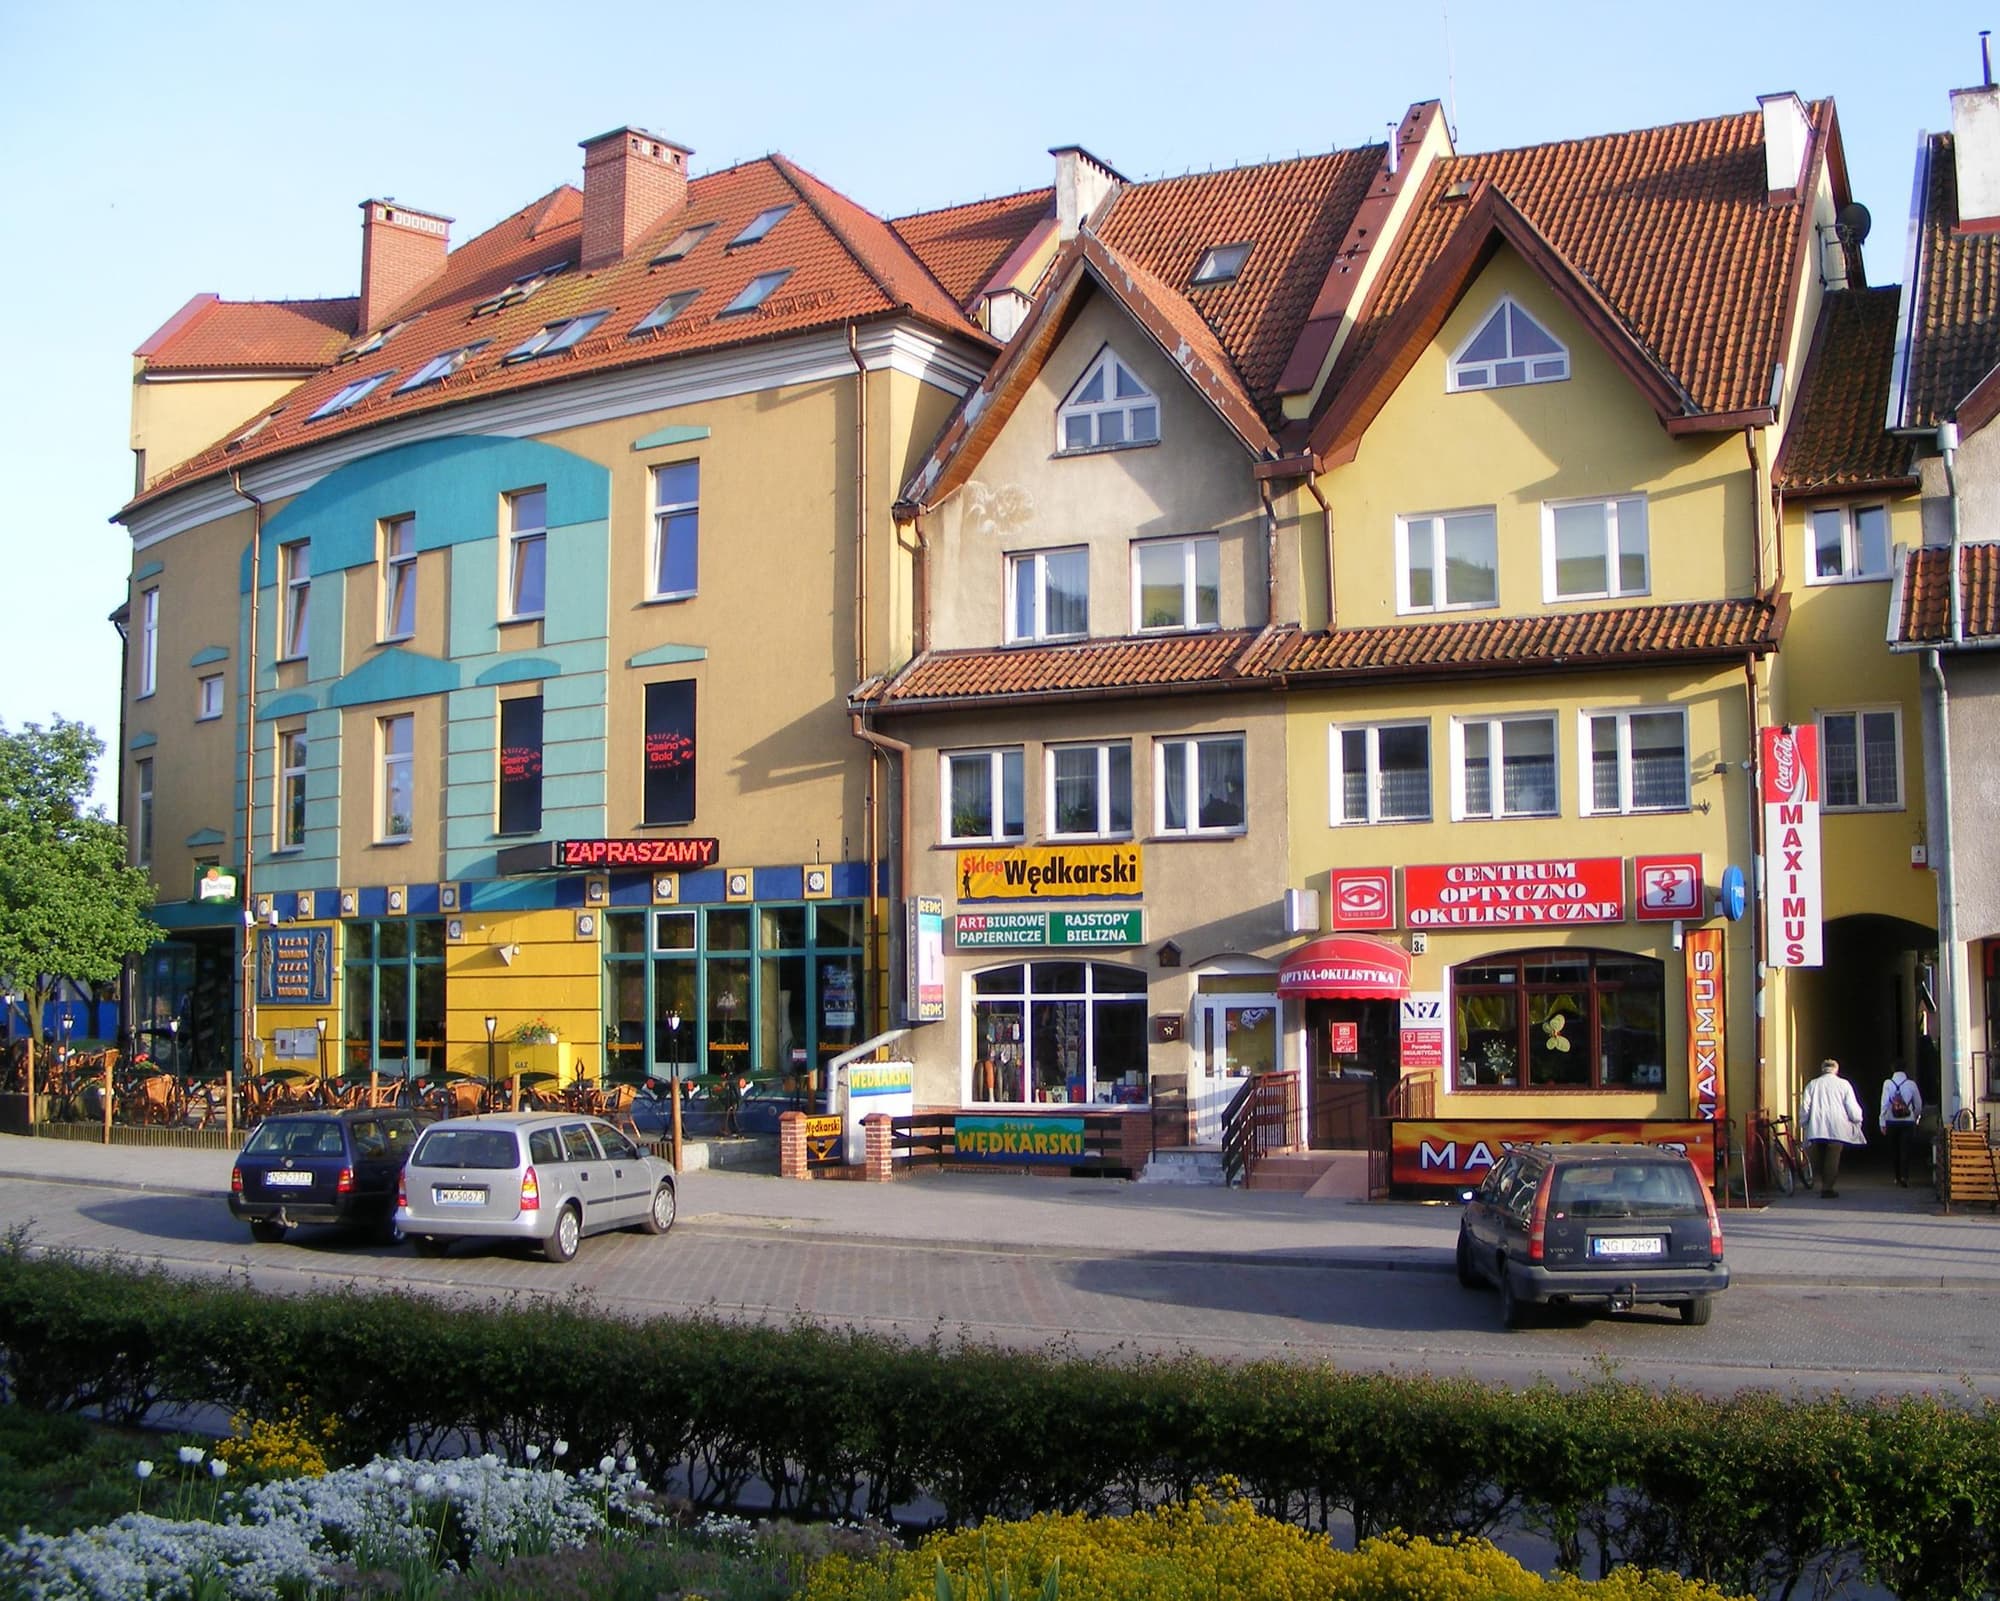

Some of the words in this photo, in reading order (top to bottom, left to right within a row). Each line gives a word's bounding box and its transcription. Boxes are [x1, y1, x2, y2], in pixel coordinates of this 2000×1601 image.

[647, 742, 679, 751] Casino
[501, 755, 530, 764] Casino
[651, 751, 673, 761] Gold
[504, 764, 525, 774] Gold
[565, 841, 713, 862] ZAPRASZAMY
[963, 857, 1003, 876] Sklep
[1003, 854, 1137, 895] Wędkarski
[1447, 862, 1577, 883] CENTRUM
[1780, 803, 1805, 966] MAXIMUS
[1440, 882, 1587, 904] OPTYCZNO
[919, 900, 941, 914] REDIS
[1410, 902, 1618, 924] OKULISTYCZNE
[959, 917, 986, 929] ART.
[986, 914, 1046, 928] BIUROWE
[1064, 913, 1130, 927] RAJSTOPY
[960, 930, 1042, 943] PAPIERNICZE
[1066, 929, 1127, 942] BIELIZNA
[1413, 941, 1425, 952] 3c
[1280, 968, 1395, 985] OPTYKA-OKULISTYKA
[920, 1003, 944, 1017] REDIS
[1403, 1001, 1441, 1018] NFZ
[957, 1132, 1082, 1157] WĘDKARSKI
[442, 1191, 455, 1201] WX
[457, 1191, 484, 1201] 50673
[1631, 1239, 1658, 1251] 2H91
